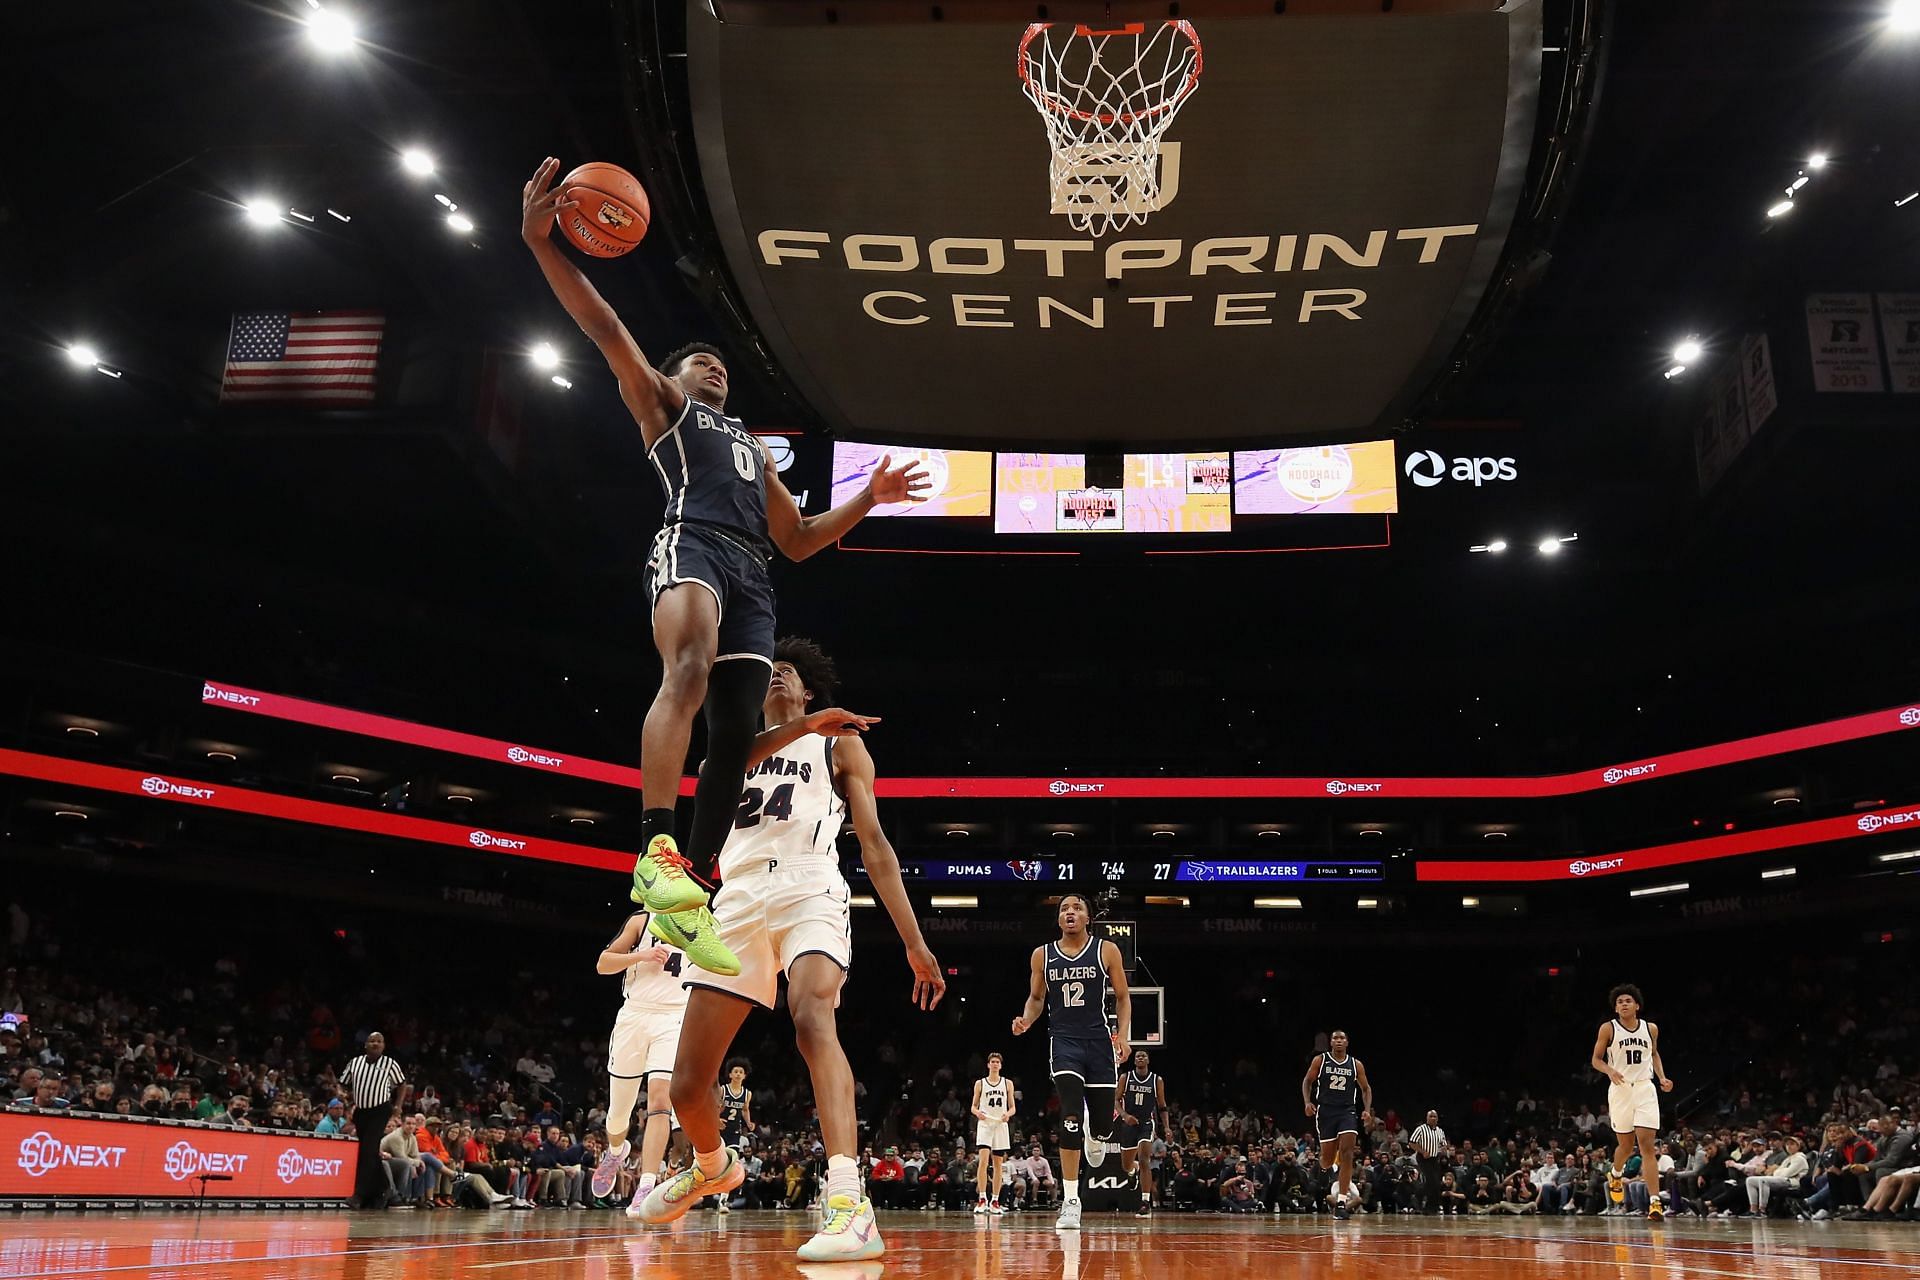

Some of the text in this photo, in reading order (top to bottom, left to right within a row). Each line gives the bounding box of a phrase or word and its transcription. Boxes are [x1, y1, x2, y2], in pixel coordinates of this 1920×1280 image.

[757, 224, 1479, 279] FOOTPRINT
[862, 288, 1368, 329] CENTER
[1830, 375, 1868, 387] 2013
[732, 442, 756, 482] 0
[1288, 470, 1342, 480] HOOPHALL
[1451, 456, 1518, 487] aps
[1074, 509, 1106, 521] WEST
[745, 756, 812, 783] UMAS
[734, 783, 796, 830] 24
[768, 859, 778, 872] P
[948, 865, 992, 875] PUMAS
[1058, 864, 1074, 880] 21
[1101, 862, 1125, 875] 7:44
[1154, 863, 1171, 880] 27
[1216, 866, 1298, 876] TRAILBLAZERS
[1105, 925, 1131, 937] 7:44
[1049, 966, 1097, 981] BLAZERS
[1061, 981, 1085, 1008] 12
[1618, 1037, 1648, 1049] PUMAS
[1325, 1066, 1352, 1076] BLAZERS
[1129, 1085, 1152, 1093] BLAZERS
[1329, 1075, 1347, 1091] 22
[988, 1097, 1003, 1108] 44
[1135, 1093, 1144, 1105] 11
[727, 1108, 737, 1121] 2
